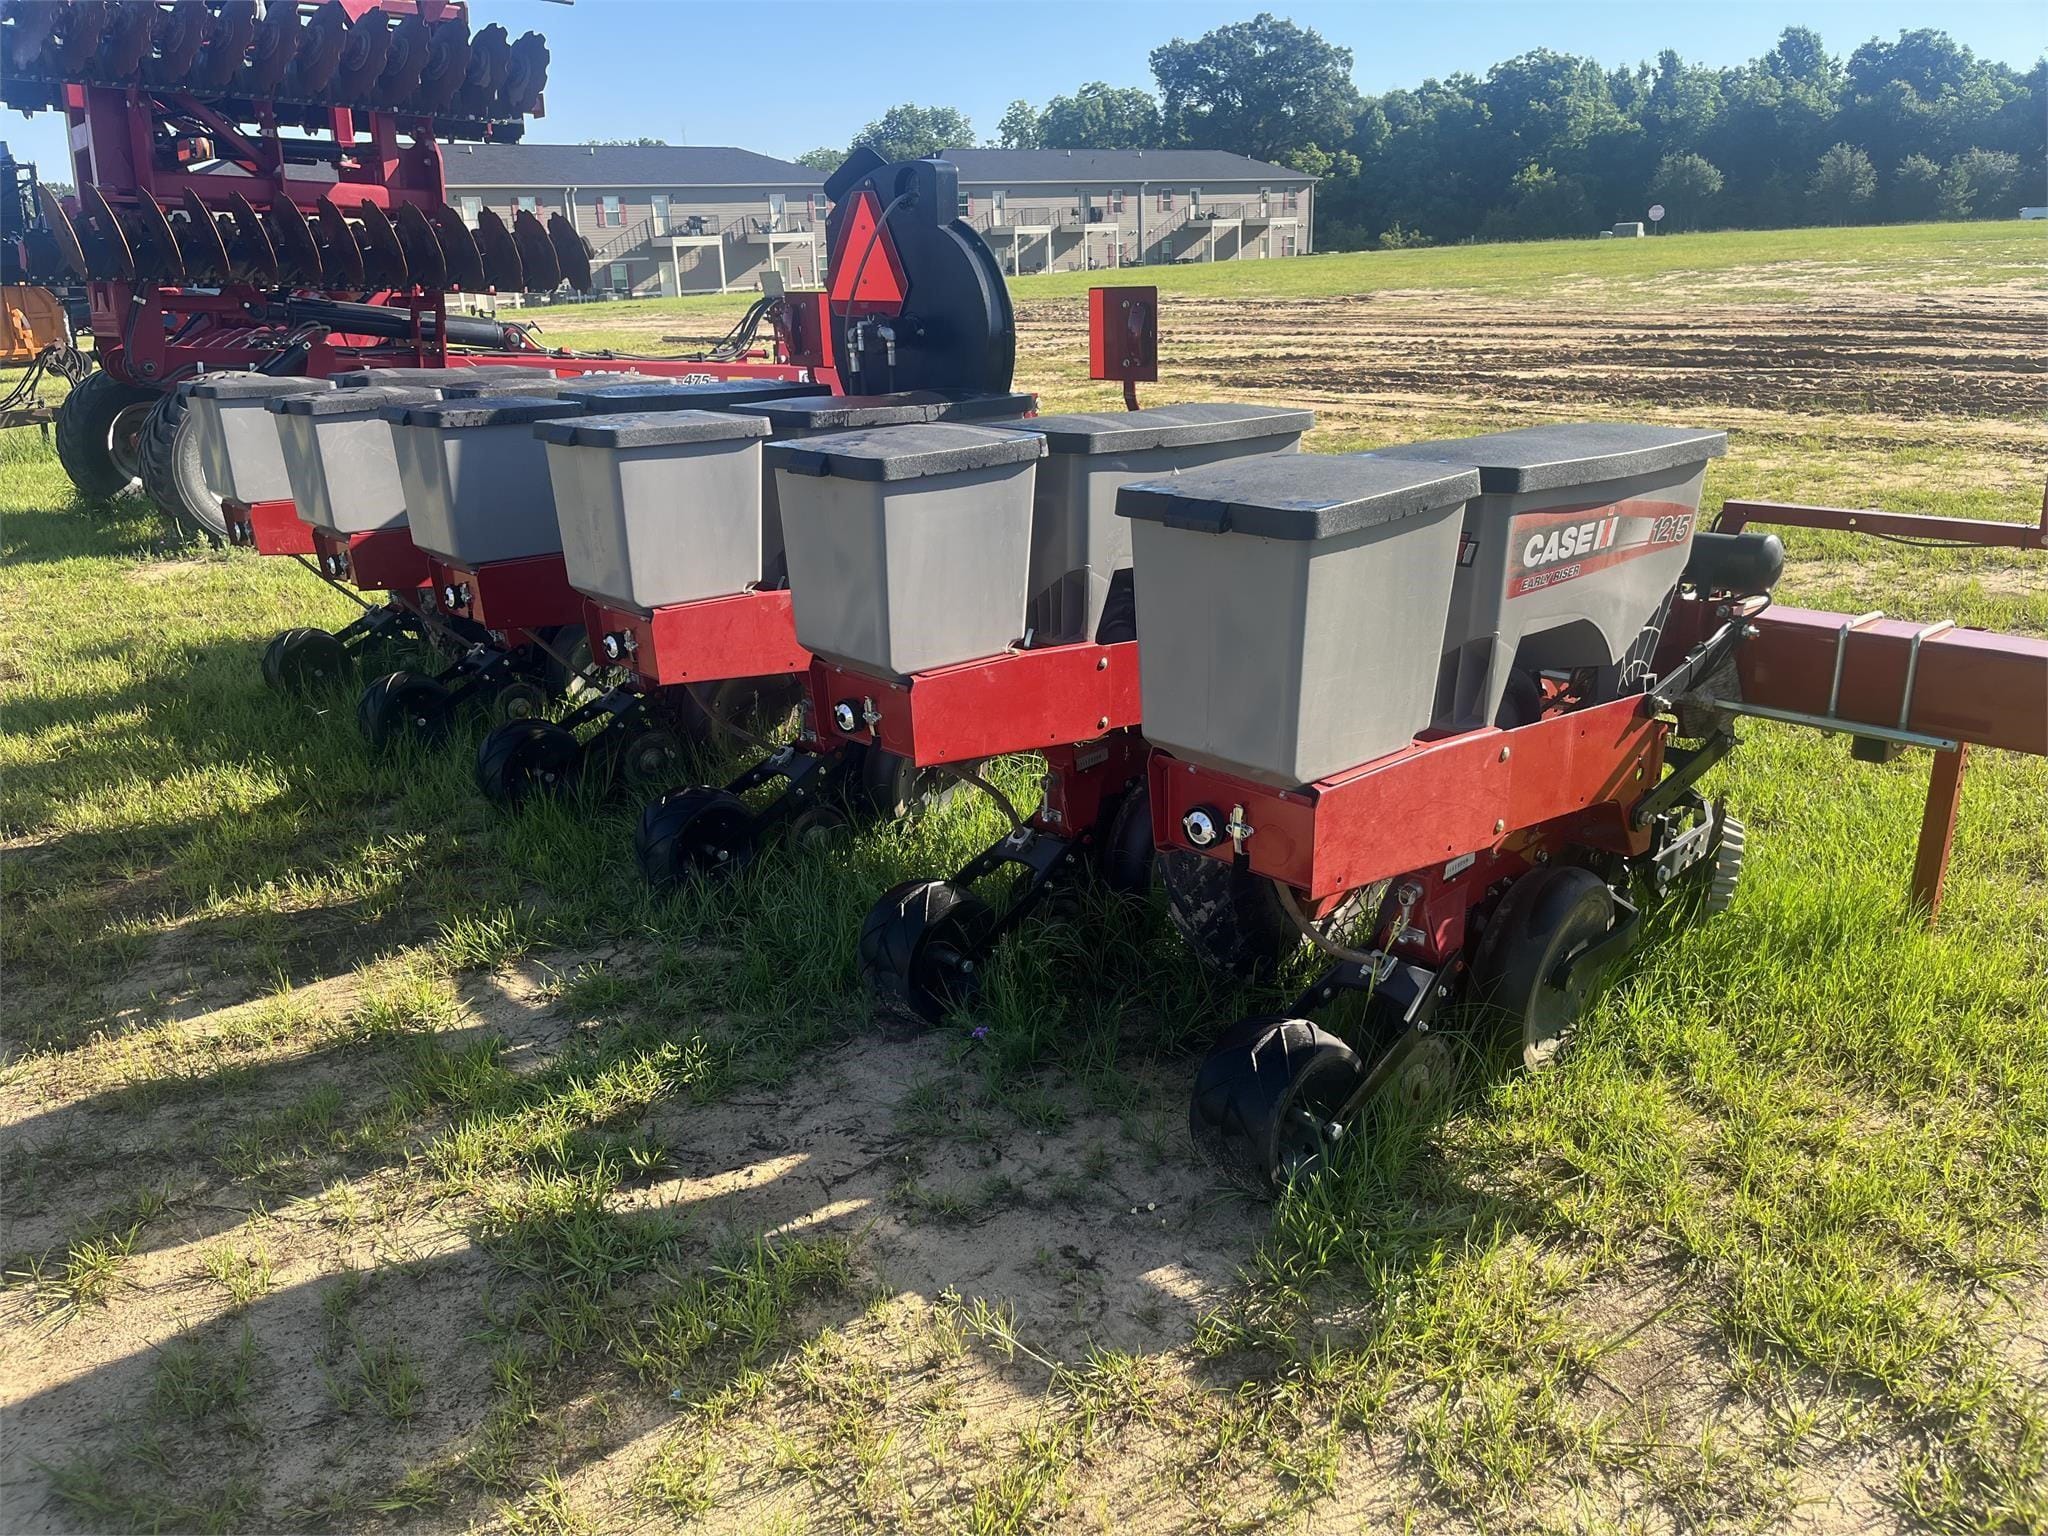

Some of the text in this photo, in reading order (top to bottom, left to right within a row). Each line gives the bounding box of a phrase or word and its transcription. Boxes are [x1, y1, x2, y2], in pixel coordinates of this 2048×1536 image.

[683, 373, 711, 385] 475
[1651, 514, 1693, 544] 1215
[1520, 564, 1581, 591] EARLY RISER
